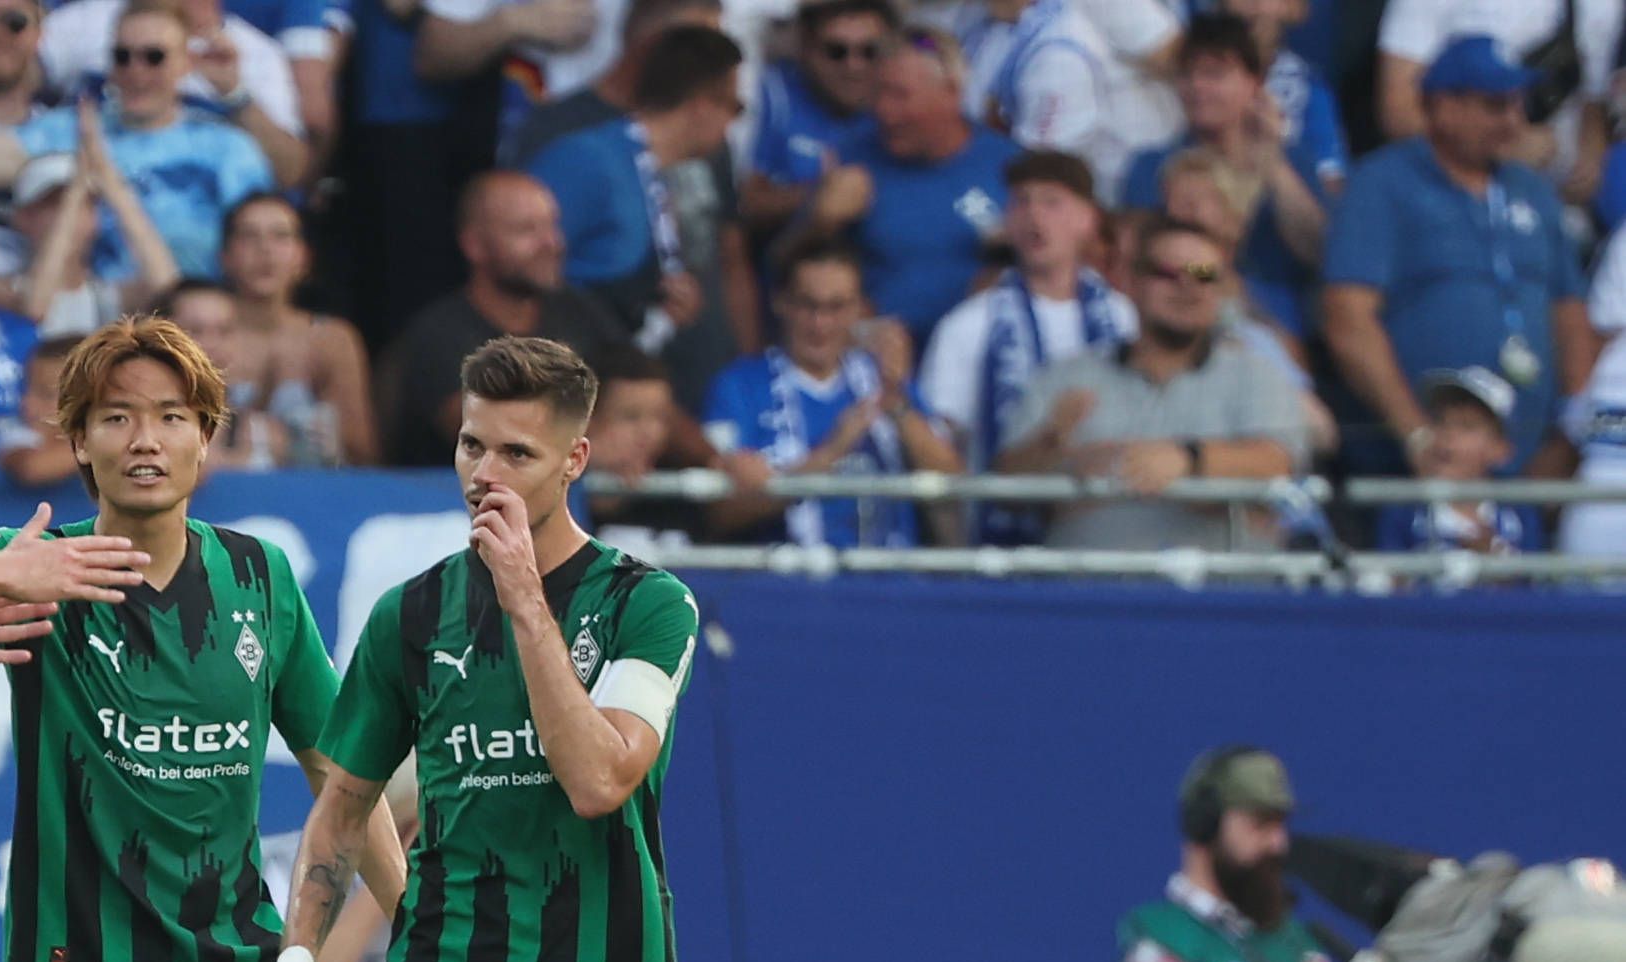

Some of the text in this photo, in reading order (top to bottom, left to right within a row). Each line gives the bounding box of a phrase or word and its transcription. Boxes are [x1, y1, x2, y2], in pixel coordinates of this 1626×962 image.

[98, 708, 250, 753] flatex
[444, 719, 546, 764] flat
[159, 766, 181, 780] bei
[183, 767, 211, 779] den
[213, 762, 250, 777] Profis
